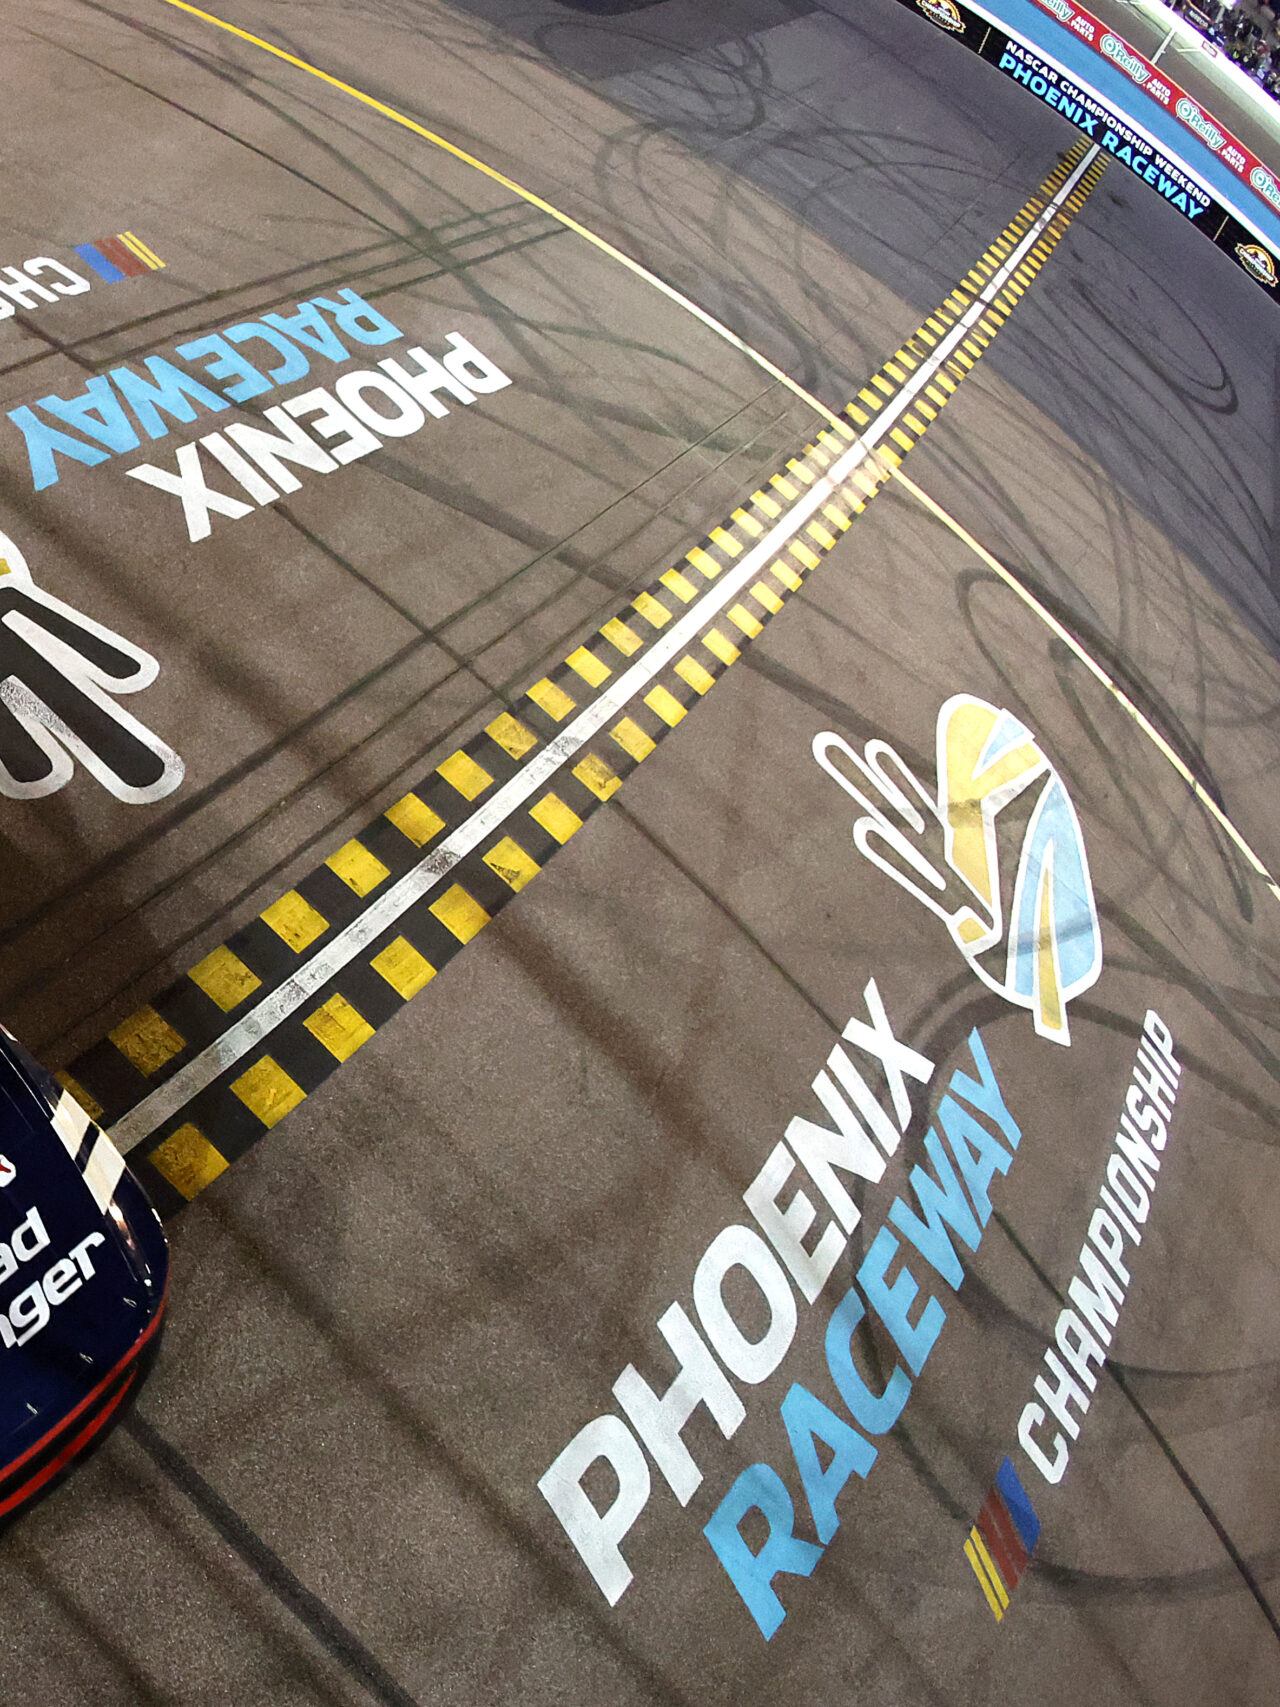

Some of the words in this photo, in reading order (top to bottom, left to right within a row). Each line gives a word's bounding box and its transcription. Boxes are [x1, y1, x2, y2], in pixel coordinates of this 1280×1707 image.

[1070, 19, 1094, 41] PARTS
[1075, 15, 1095, 33] AUTO
[1102, 35, 1149, 82] O'Reilly
[1146, 81, 1170, 105] PARTS
[1151, 78, 1172, 97] AUTO
[999, 53, 1099, 136] PHOENIX
[1101, 130, 1204, 220] RACEWAY
[1006, 41, 1058, 84] NASCAR
[1060, 80, 1153, 156] CHAMPIONSHIP
[1155, 153, 1210, 208] WEEKEND
[1177, 100, 1225, 149] O'Reilly
[1221, 149, 1244, 173] PARTS
[1226, 145, 1246, 164] AUTO
[6, 288, 405, 491] RACEWAY
[125, 331, 513, 543] PHOENIX
[1017, 1009, 1183, 1484] CHAMPIONSHIP
[536, 977, 936, 1607] PHOENIX
[702, 1026, 1022, 1642] RACEWAY
